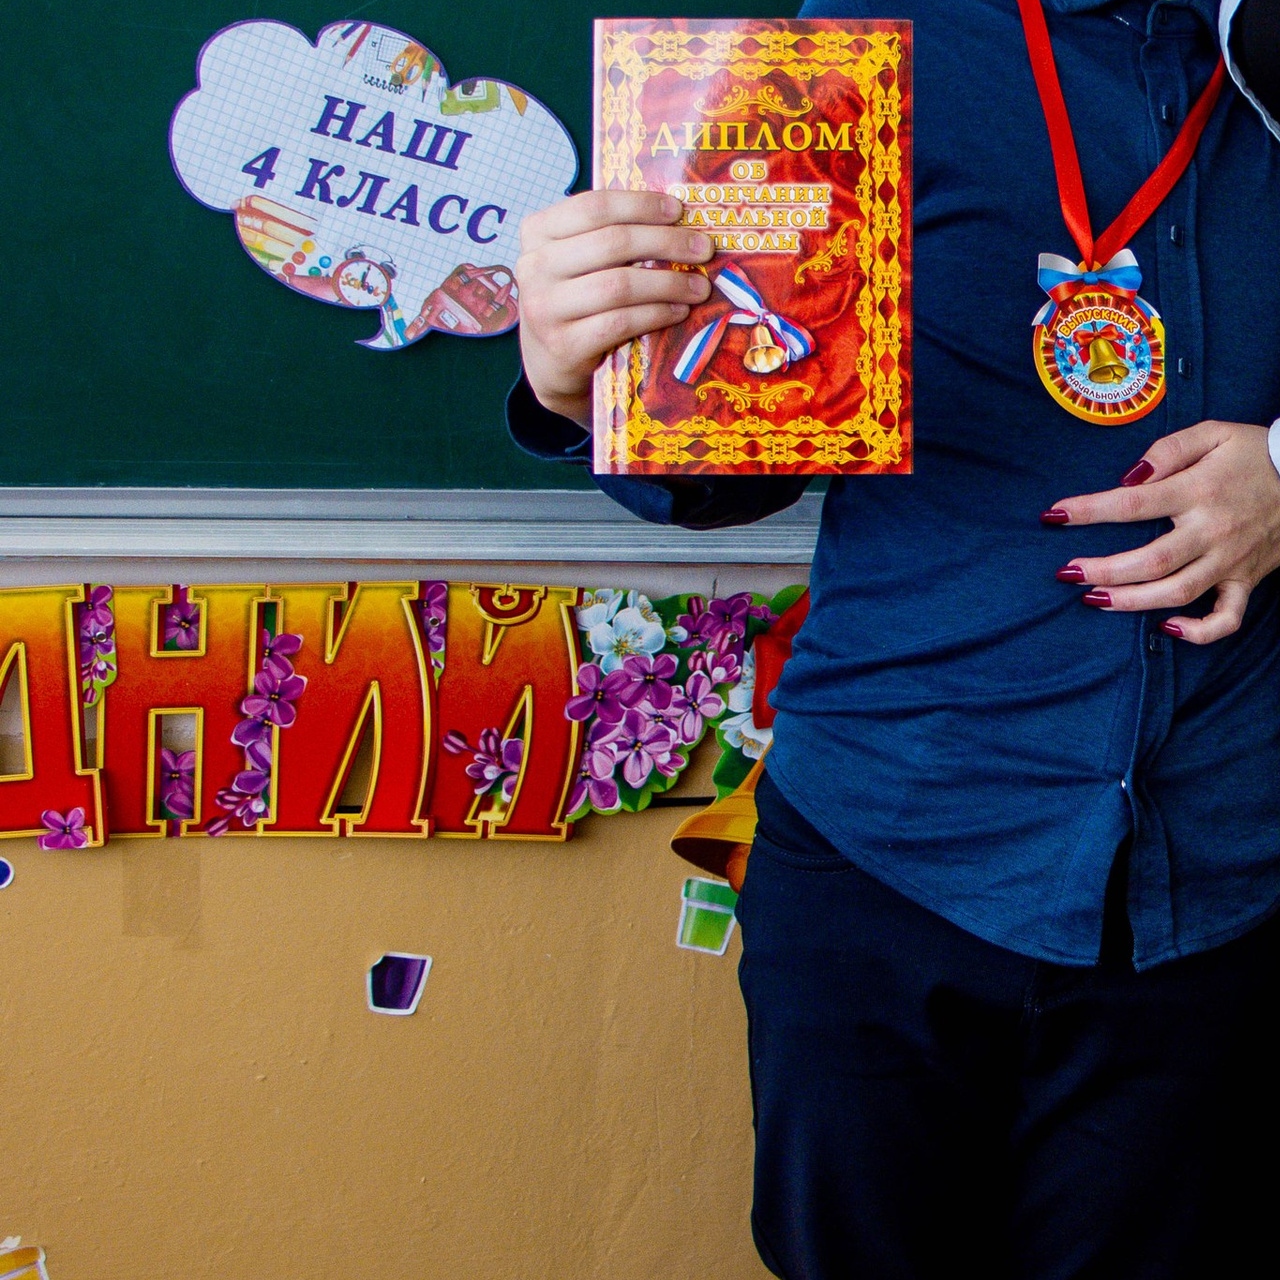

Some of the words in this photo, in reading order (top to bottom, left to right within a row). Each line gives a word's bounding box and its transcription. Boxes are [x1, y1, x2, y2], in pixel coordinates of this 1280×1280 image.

[310, 94, 473, 171] НАШ
[651, 122, 854, 157] ДИПЛОМ
[732, 162, 766, 180] ОБ
[241, 147, 281, 189] 4
[295, 157, 507, 244] КЛАСС
[669, 185, 830, 204] ОКОНЧАНИИ
[1059, 307, 1138, 337] ВЫПУСКНИК
[1067, 375, 1120, 400] НАЧАЛЬНОЙ
[1121, 370, 1147, 396] ШКОЛЫ
